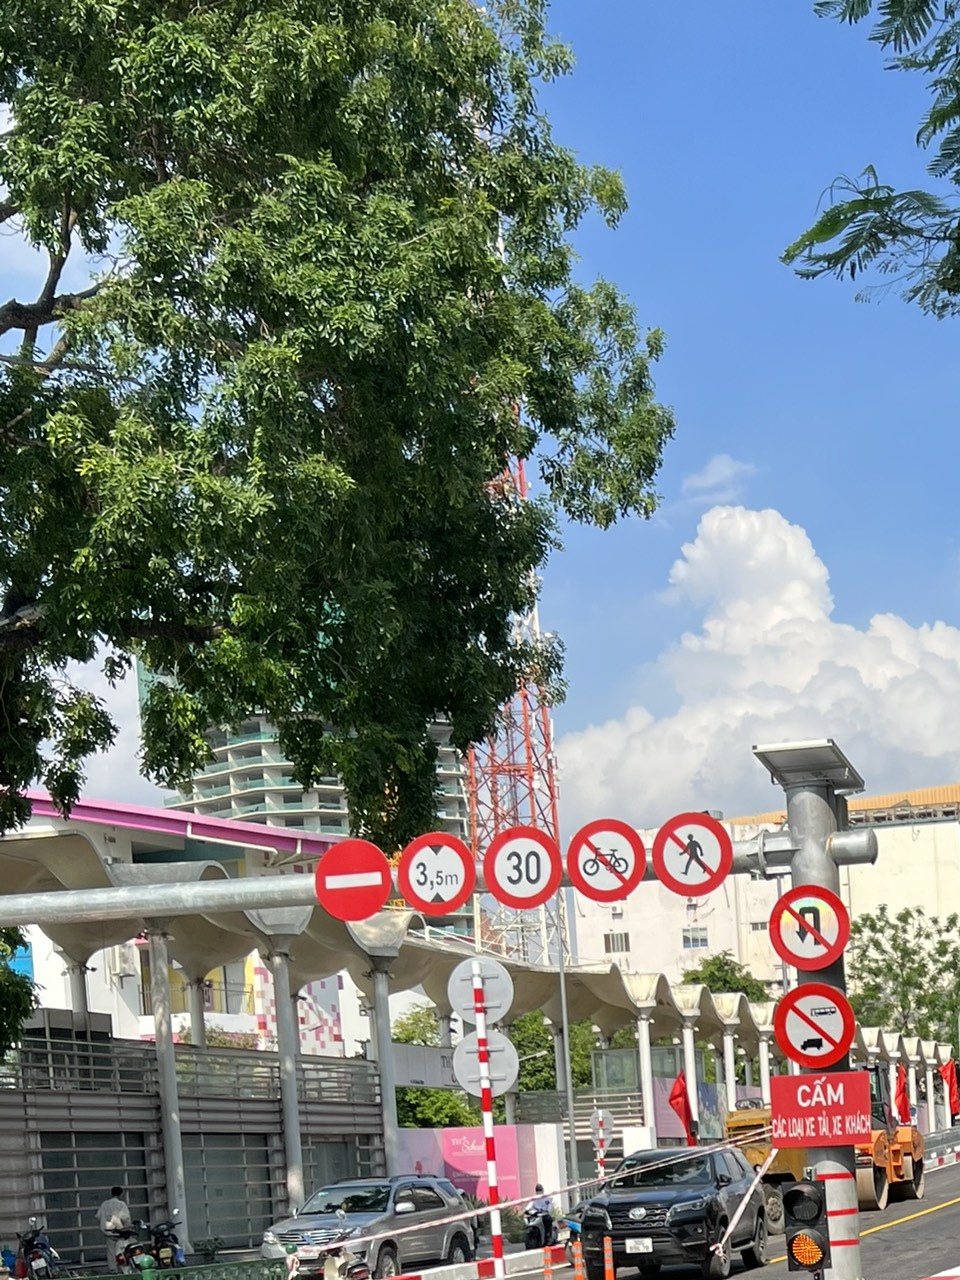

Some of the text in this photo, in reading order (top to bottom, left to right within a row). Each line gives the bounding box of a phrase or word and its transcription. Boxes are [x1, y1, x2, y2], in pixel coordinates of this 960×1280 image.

[416, 862, 459, 890] 3,5m
[506, 850, 541, 886] 30
[797, 1076, 844, 1107] CẤM
[772, 1110, 871, 1140] CÁC LOẠI XE TẢI, XE KHÁCH
